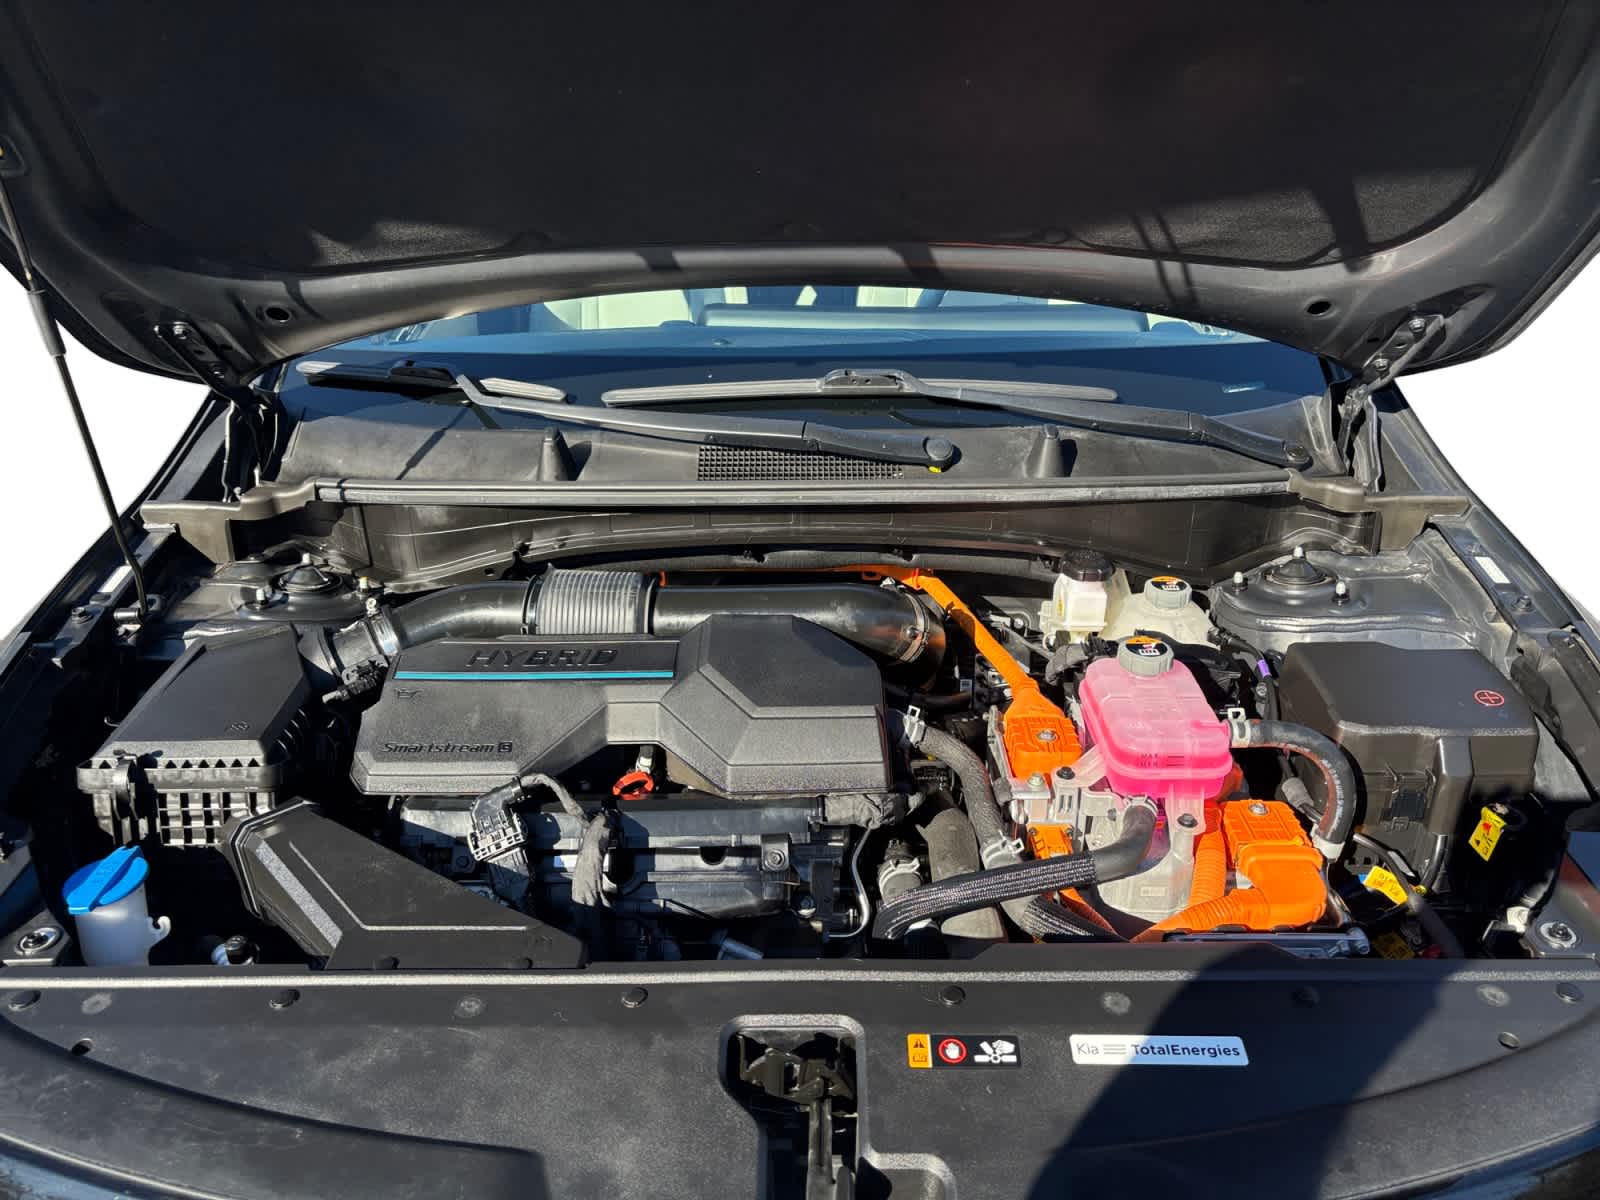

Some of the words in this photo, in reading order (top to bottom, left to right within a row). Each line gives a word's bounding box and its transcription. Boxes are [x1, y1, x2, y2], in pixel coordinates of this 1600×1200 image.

[465, 649, 619, 668] HYBRID
[382, 741, 495, 753] Smartstream
[1076, 1041, 1100, 1056] Kia
[1131, 1043, 1241, 1057] TotalEnergies
